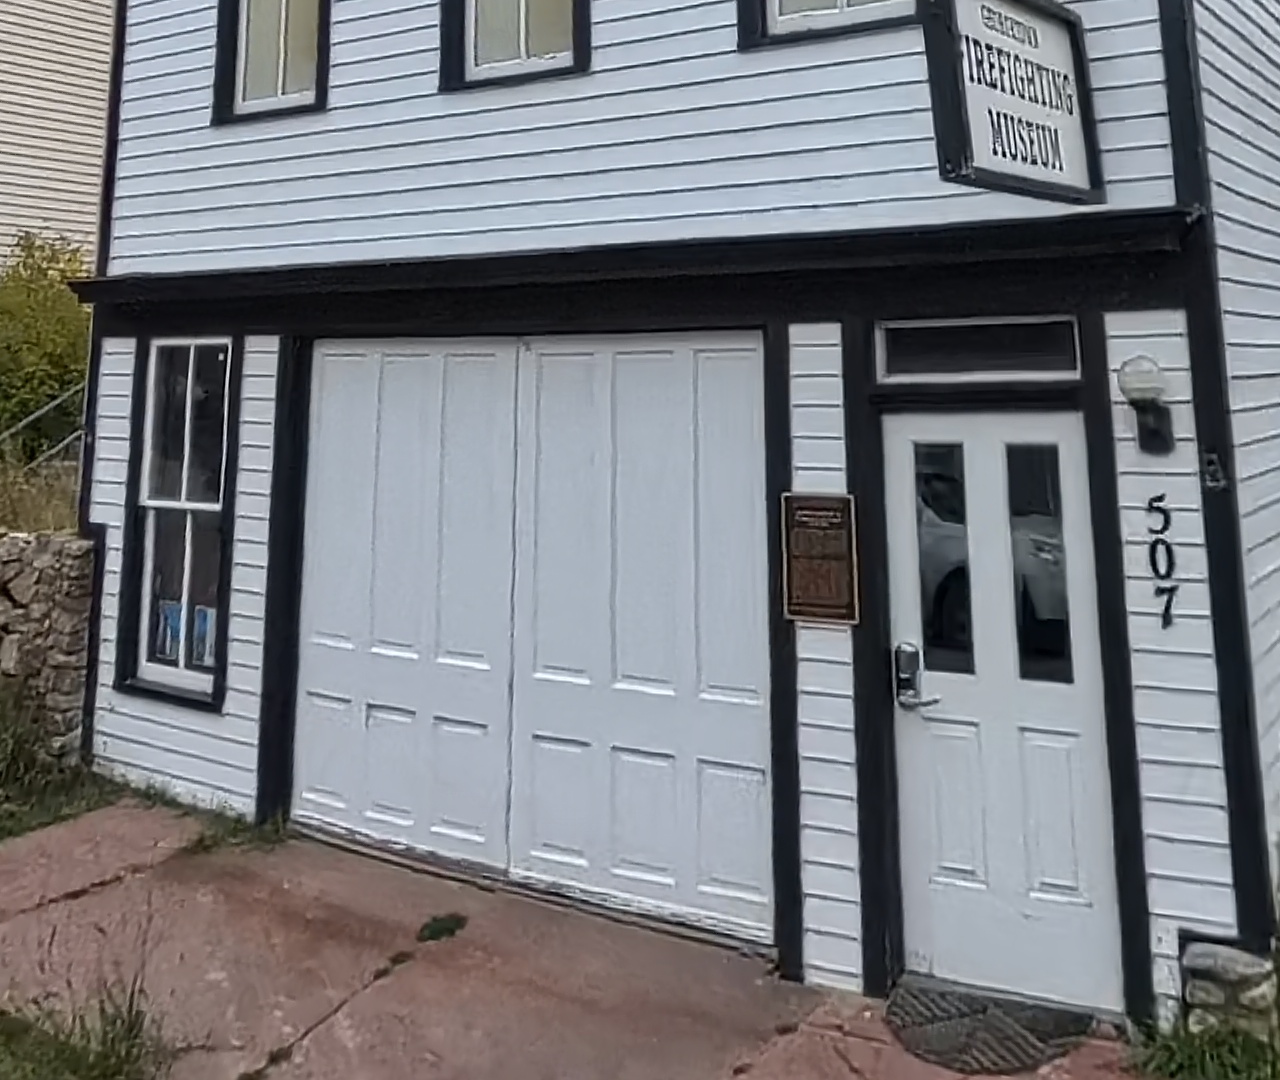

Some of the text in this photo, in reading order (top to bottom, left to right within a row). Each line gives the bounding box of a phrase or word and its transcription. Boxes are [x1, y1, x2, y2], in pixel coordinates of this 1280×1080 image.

[964, 35, 1073, 115] IREFIGHTING
[988, 109, 1063, 171] MUSEUM
[1148, 493, 1179, 630] 507
